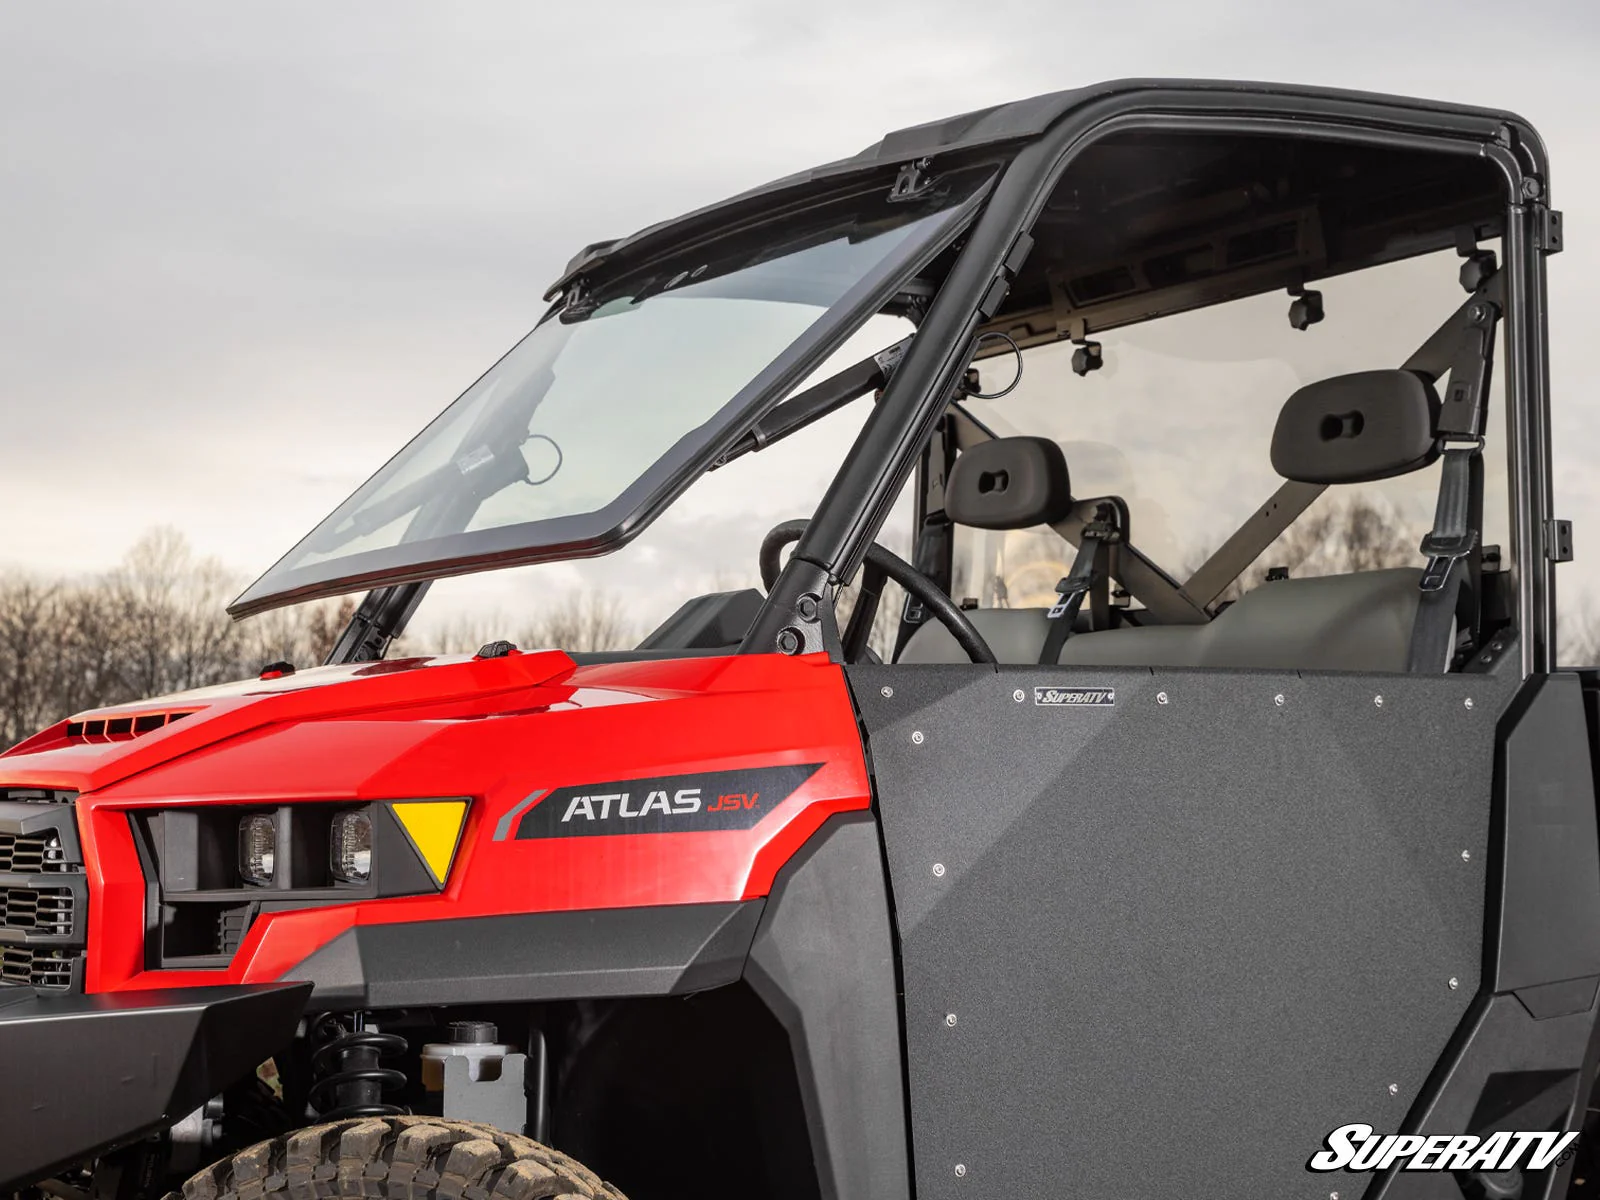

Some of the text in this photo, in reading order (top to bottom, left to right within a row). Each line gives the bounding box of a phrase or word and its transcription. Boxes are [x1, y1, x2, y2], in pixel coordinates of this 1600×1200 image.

[1042, 690, 1107, 703] SUPERATV
[561, 788, 758, 822] ATLAS JSV
